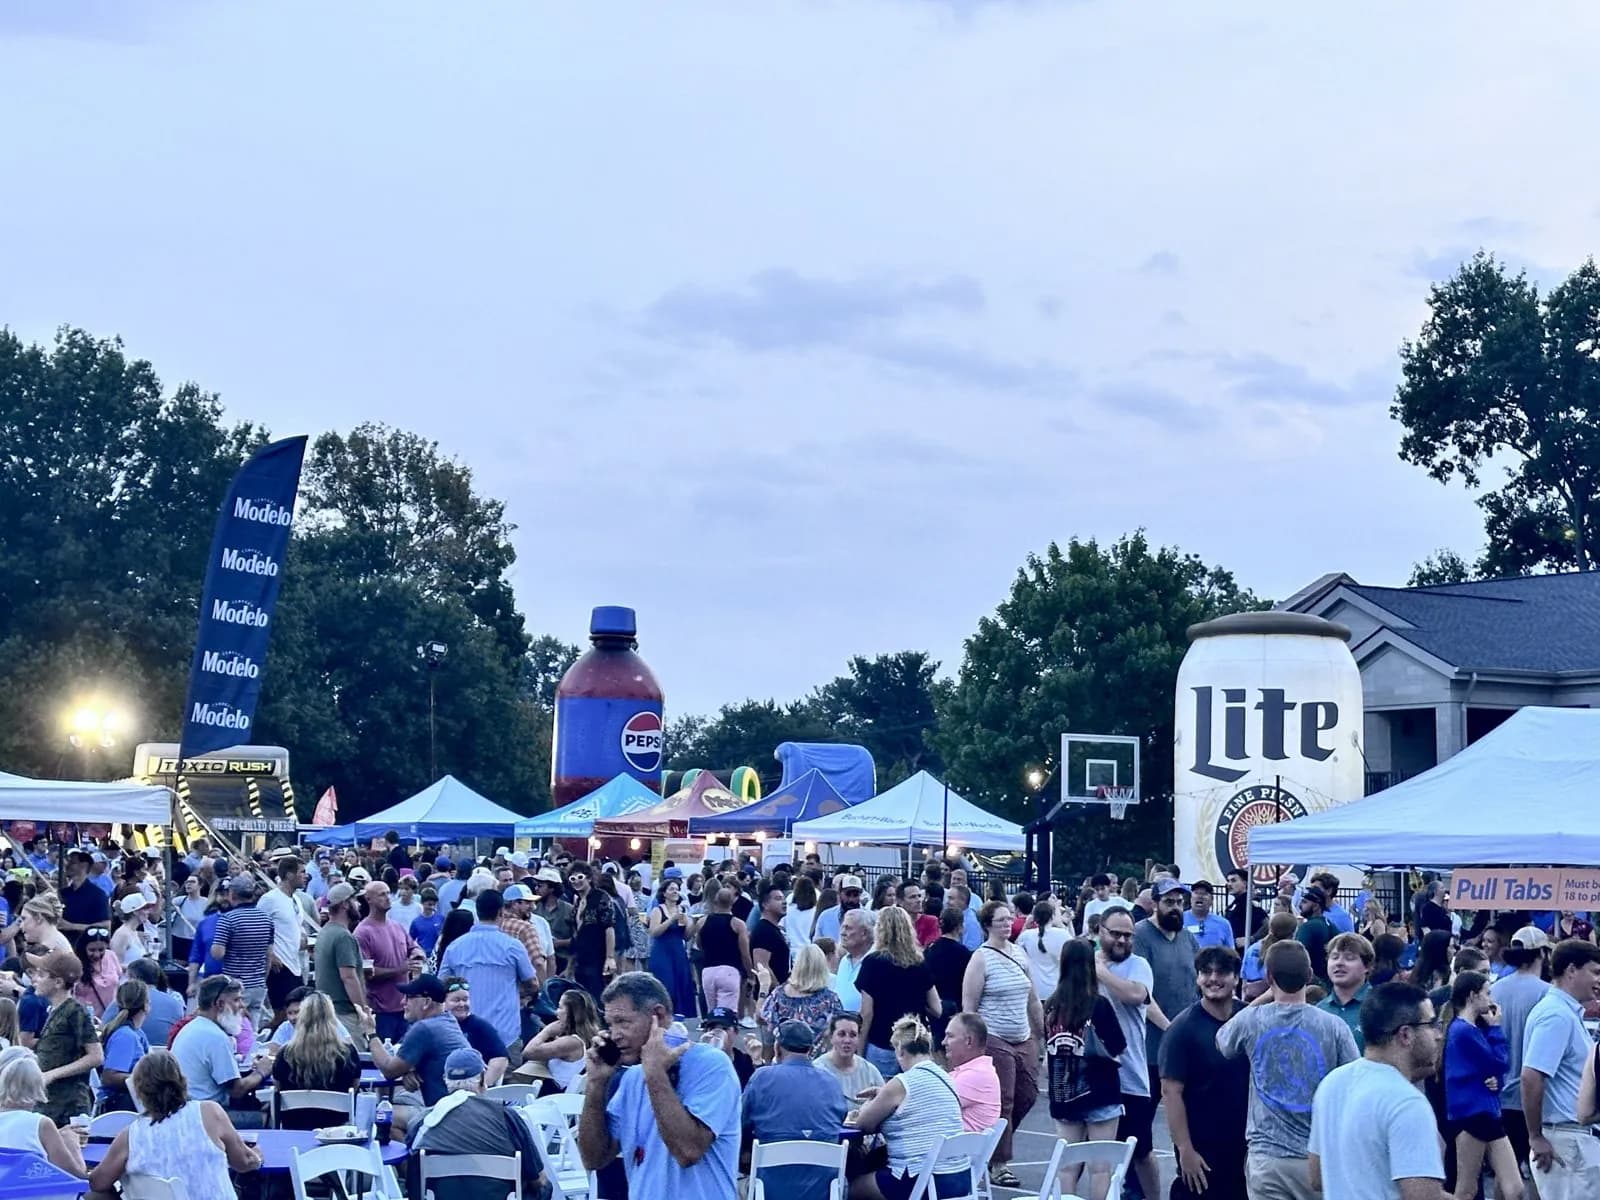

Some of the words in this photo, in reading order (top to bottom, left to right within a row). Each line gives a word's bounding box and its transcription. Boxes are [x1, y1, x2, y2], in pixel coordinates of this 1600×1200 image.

[234, 497, 291, 526] Modelo
[221, 547, 278, 577] Modelo
[212, 599, 268, 627] Modelo
[202, 650, 259, 679] Modelo
[191, 702, 249, 730] Modelo
[1189, 686, 1338, 783] Lite
[164, 761, 224, 772] TOXIC
[229, 761, 272, 772] RUSH
[1223, 790, 1255, 820] FINE
[1219, 824, 1229, 834] A
[1456, 878, 1498, 900] Pull
[1504, 878, 1552, 900] Tabs
[1565, 879, 1589, 889] Must
[1565, 891, 1575, 901] 18
[1578, 892, 1588, 901] to
